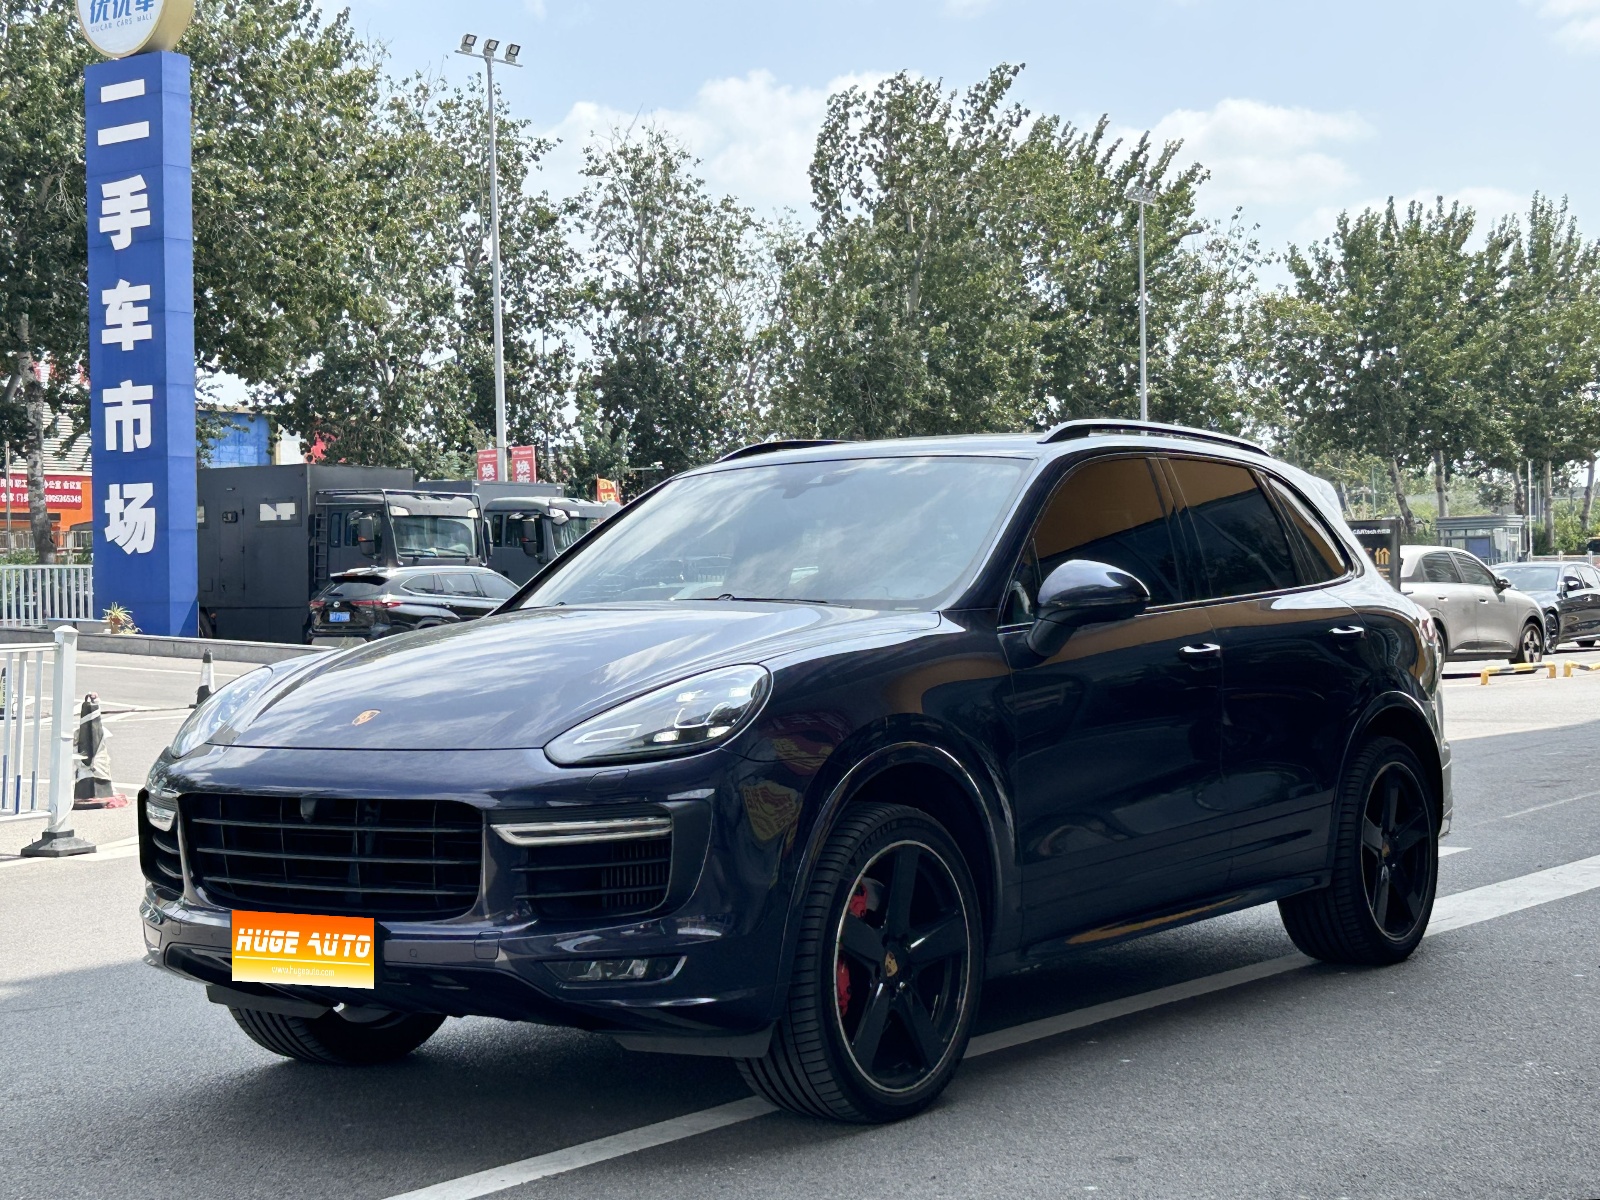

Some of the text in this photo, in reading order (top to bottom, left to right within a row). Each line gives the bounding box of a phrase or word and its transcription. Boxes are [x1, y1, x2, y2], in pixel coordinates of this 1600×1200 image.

[116, 17, 133, 28] CARS
[137, 13, 153, 22] MALL
[97, 79, 156, 555] 二手车市场
